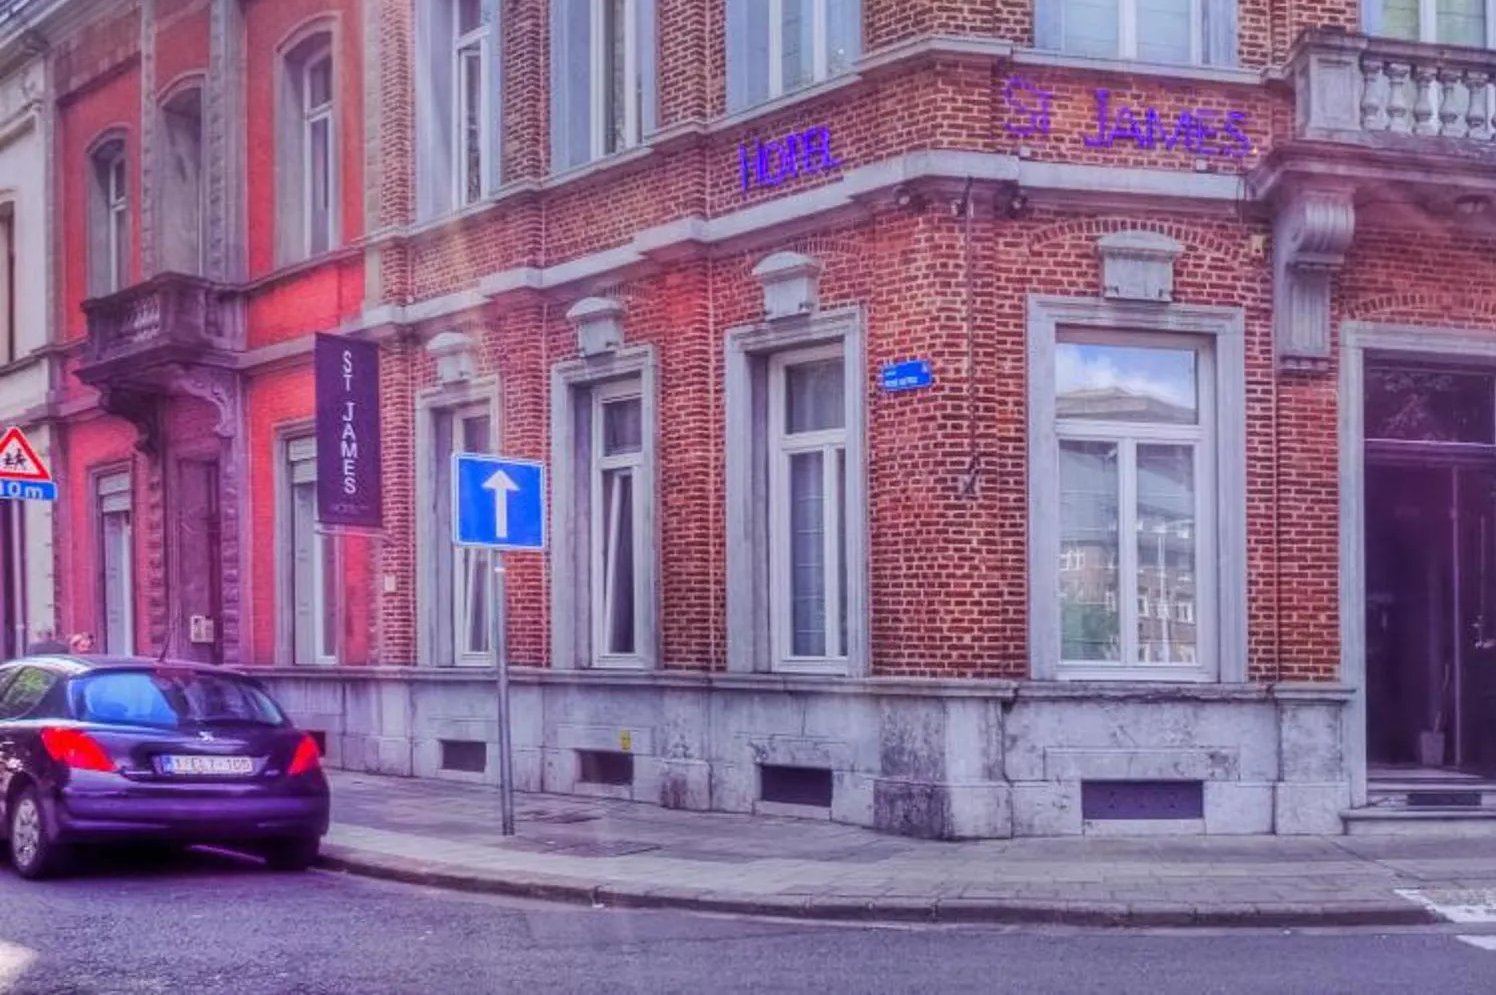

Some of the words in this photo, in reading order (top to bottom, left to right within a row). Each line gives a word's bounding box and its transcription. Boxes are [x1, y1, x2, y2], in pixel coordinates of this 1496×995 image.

[738, 125, 841, 193] HOTEL
[341, 350, 353, 391] ST
[340, 402, 358, 494] JAMES
